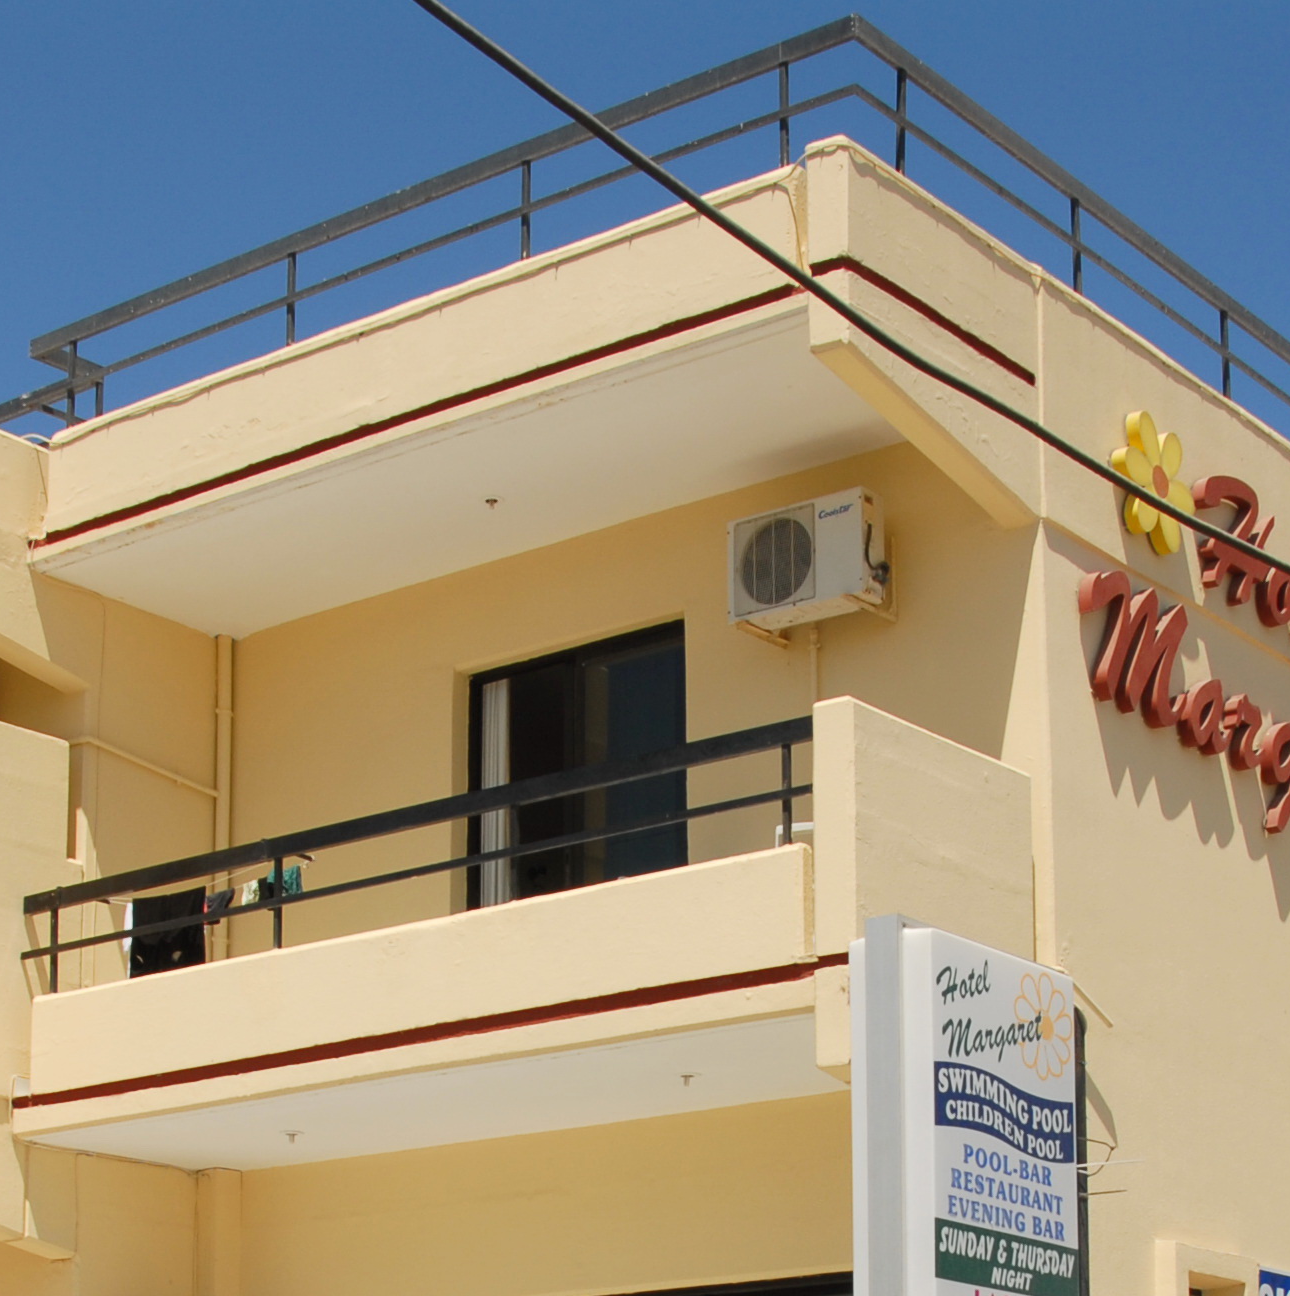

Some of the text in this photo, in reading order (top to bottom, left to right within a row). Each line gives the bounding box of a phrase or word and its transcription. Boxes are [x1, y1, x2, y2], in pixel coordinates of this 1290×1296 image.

[936, 959, 991, 1005] Hotel
[941, 1011, 1042, 1063] Margaret
[938, 1067, 1072, 1134] SWIMMING POOL
[945, 1100, 1063, 1160] CHILDREN POOL
[962, 1144, 1052, 1187] POOL-BAR
[950, 1167, 1063, 1216] RESTAURANT
[947, 1195, 1065, 1242] EVENING BAR
[939, 1226, 1075, 1279] SUNDAY & THURSDAY
[990, 1265, 1033, 1291] NIGHT
